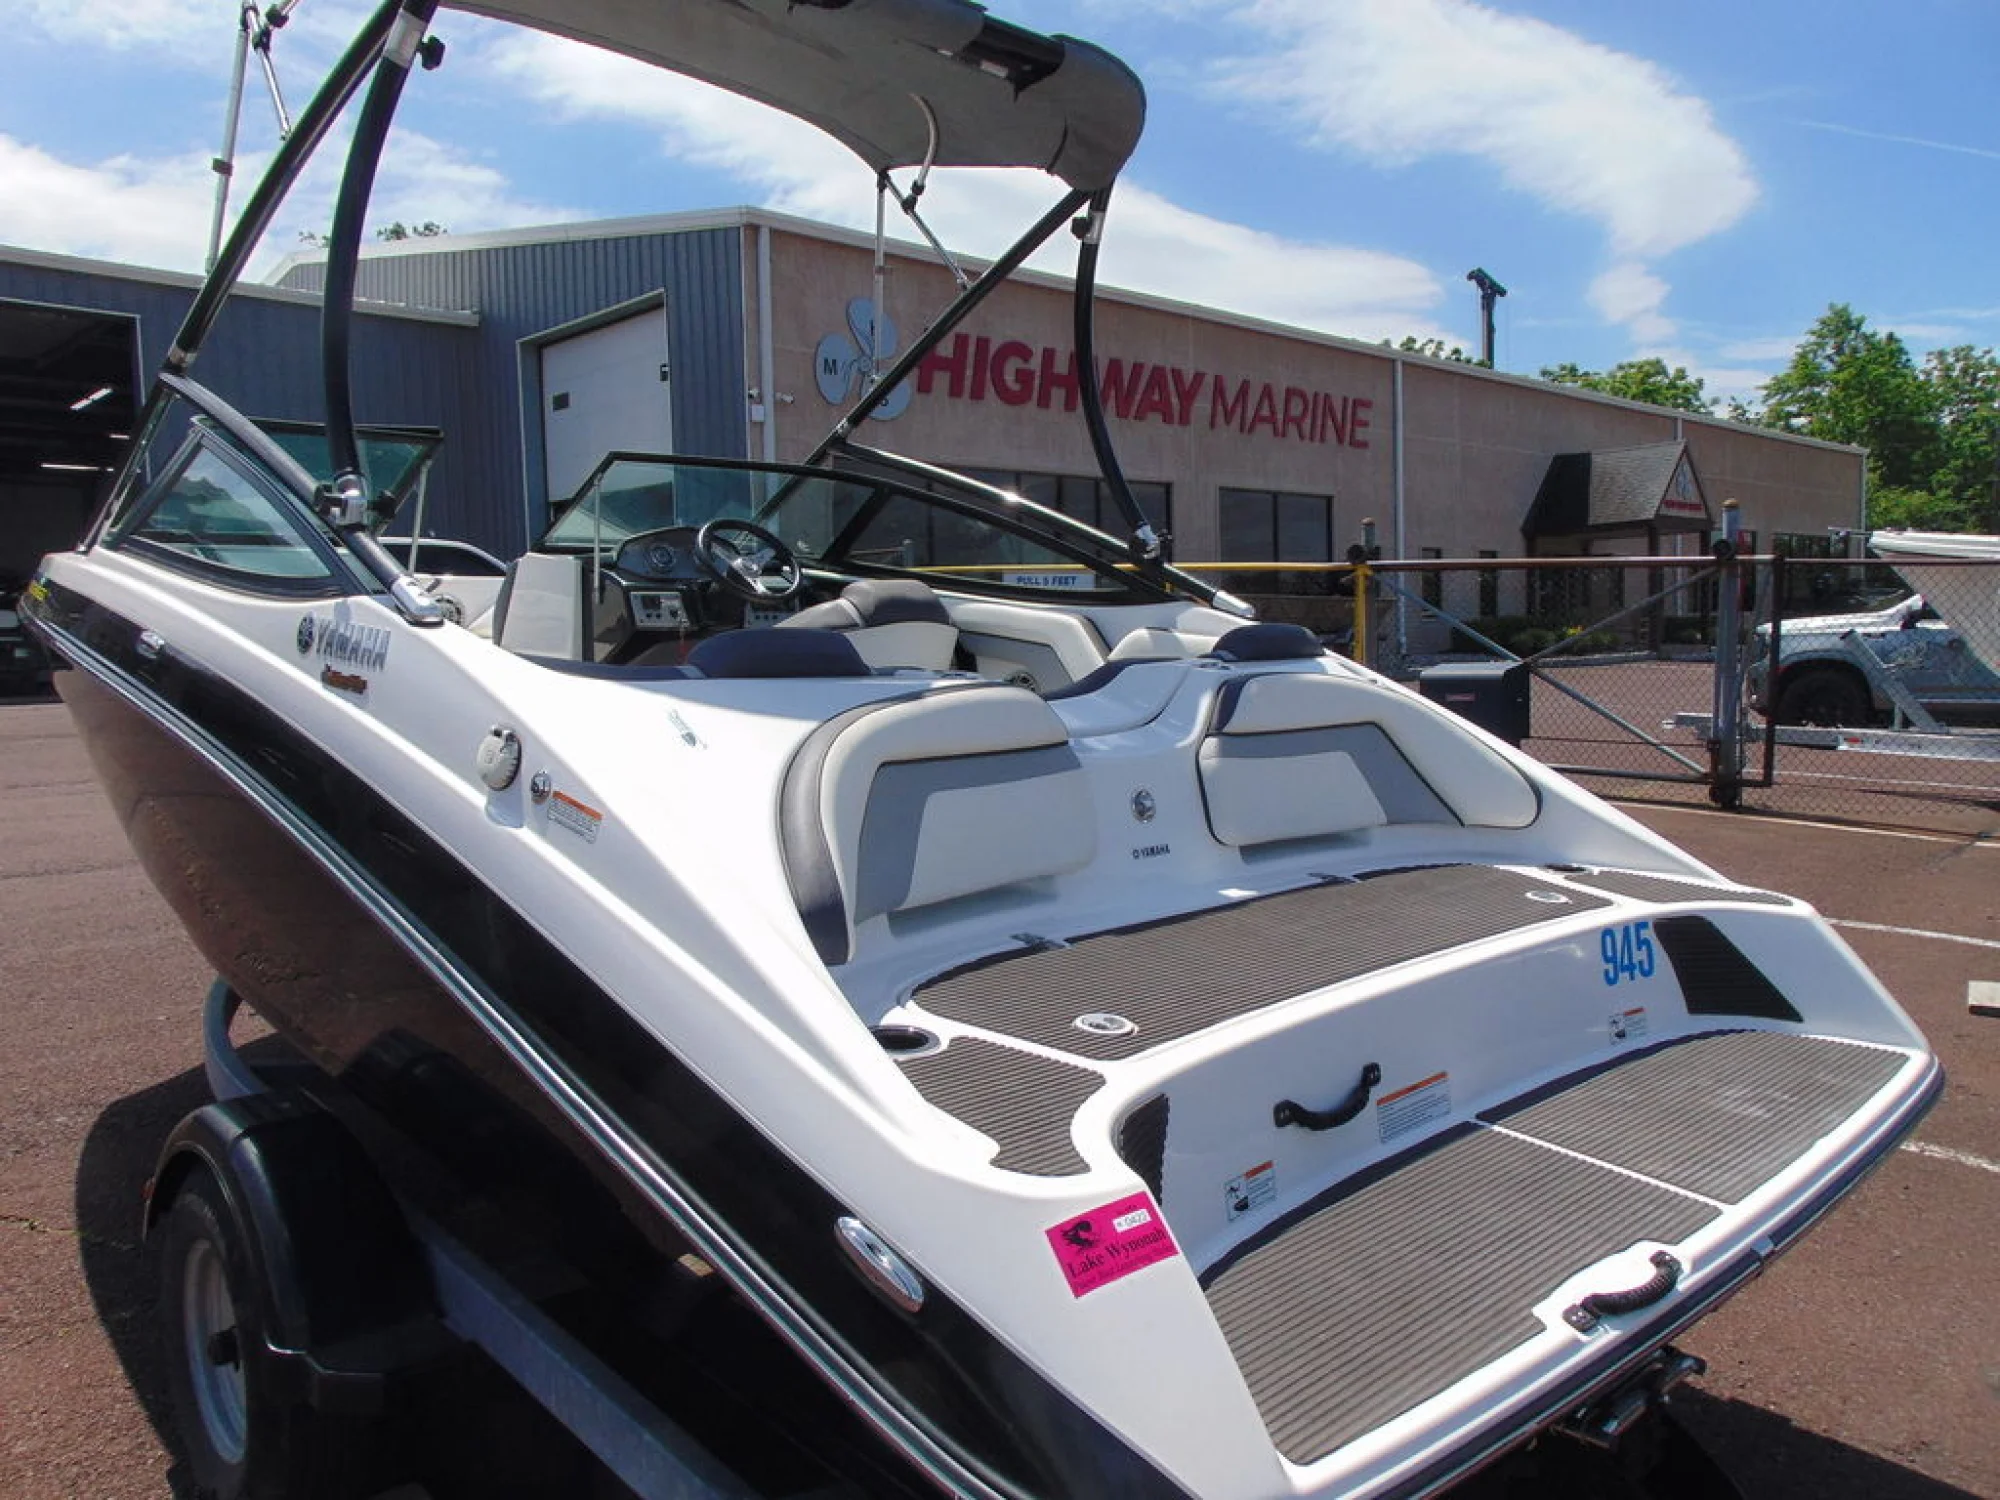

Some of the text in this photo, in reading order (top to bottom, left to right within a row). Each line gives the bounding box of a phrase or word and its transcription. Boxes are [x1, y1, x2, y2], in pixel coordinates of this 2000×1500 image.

[916, 332, 1374, 449] HIGHWAY MARINE
[315, 618, 392, 672] YAMAHA
[1601, 921, 1655, 986] 945
[1067, 1251, 1105, 1278] Lake
